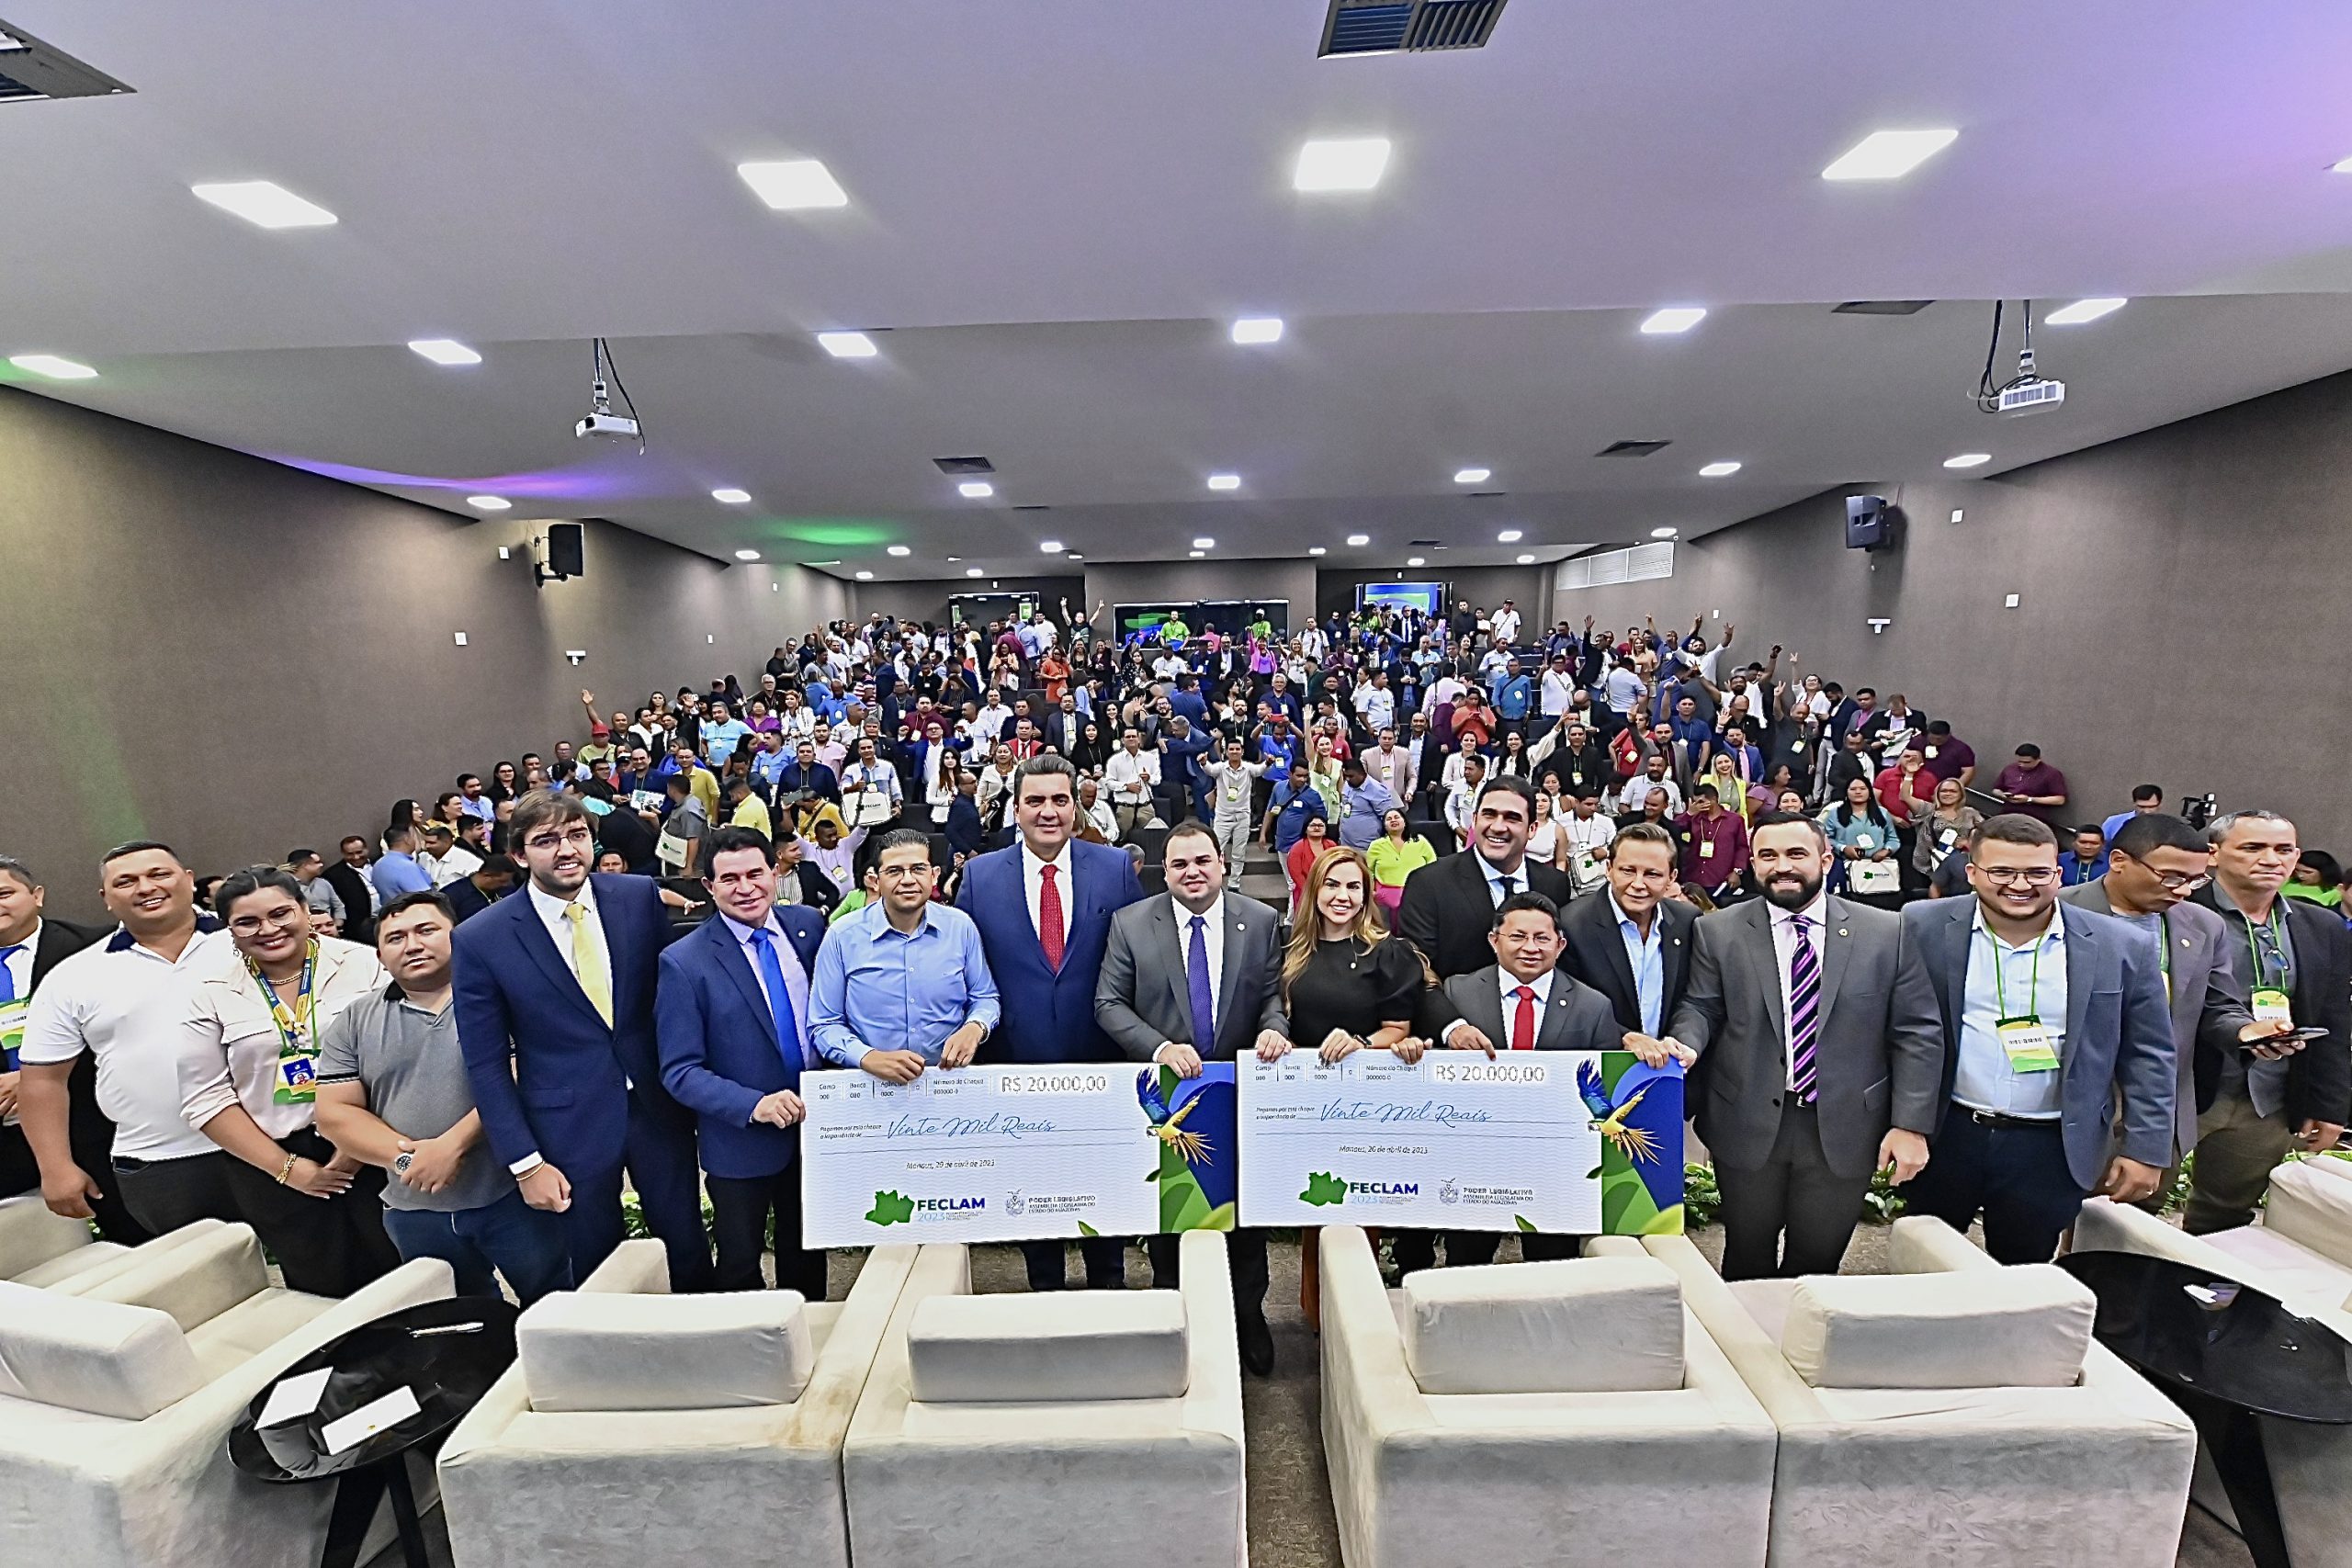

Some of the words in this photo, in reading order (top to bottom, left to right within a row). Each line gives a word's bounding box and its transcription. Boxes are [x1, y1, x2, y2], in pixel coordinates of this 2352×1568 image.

[1435, 1065, 1456, 1082] R$
[1461, 1066, 1545, 1084] 20.000,00
[1001, 1076, 1022, 1094] R$
[1026, 1076, 1106, 1093] 20.000,00
[1320, 1098, 1374, 1122] Vinte
[1375, 1100, 1433, 1123] Mil
[1434, 1104, 1493, 1129] Reais
[888, 1114, 941, 1139] Vinte
[942, 1112, 1000, 1137] Mil
[1001, 1116, 1057, 1139] Reais
[944, 1160, 953, 1168] de
[1350, 1182, 1419, 1195] FECLAM
[917, 1198, 985, 1212] FECLAM
[1351, 1195, 1378, 1204] 2023
[918, 1212, 945, 1222] 2023
